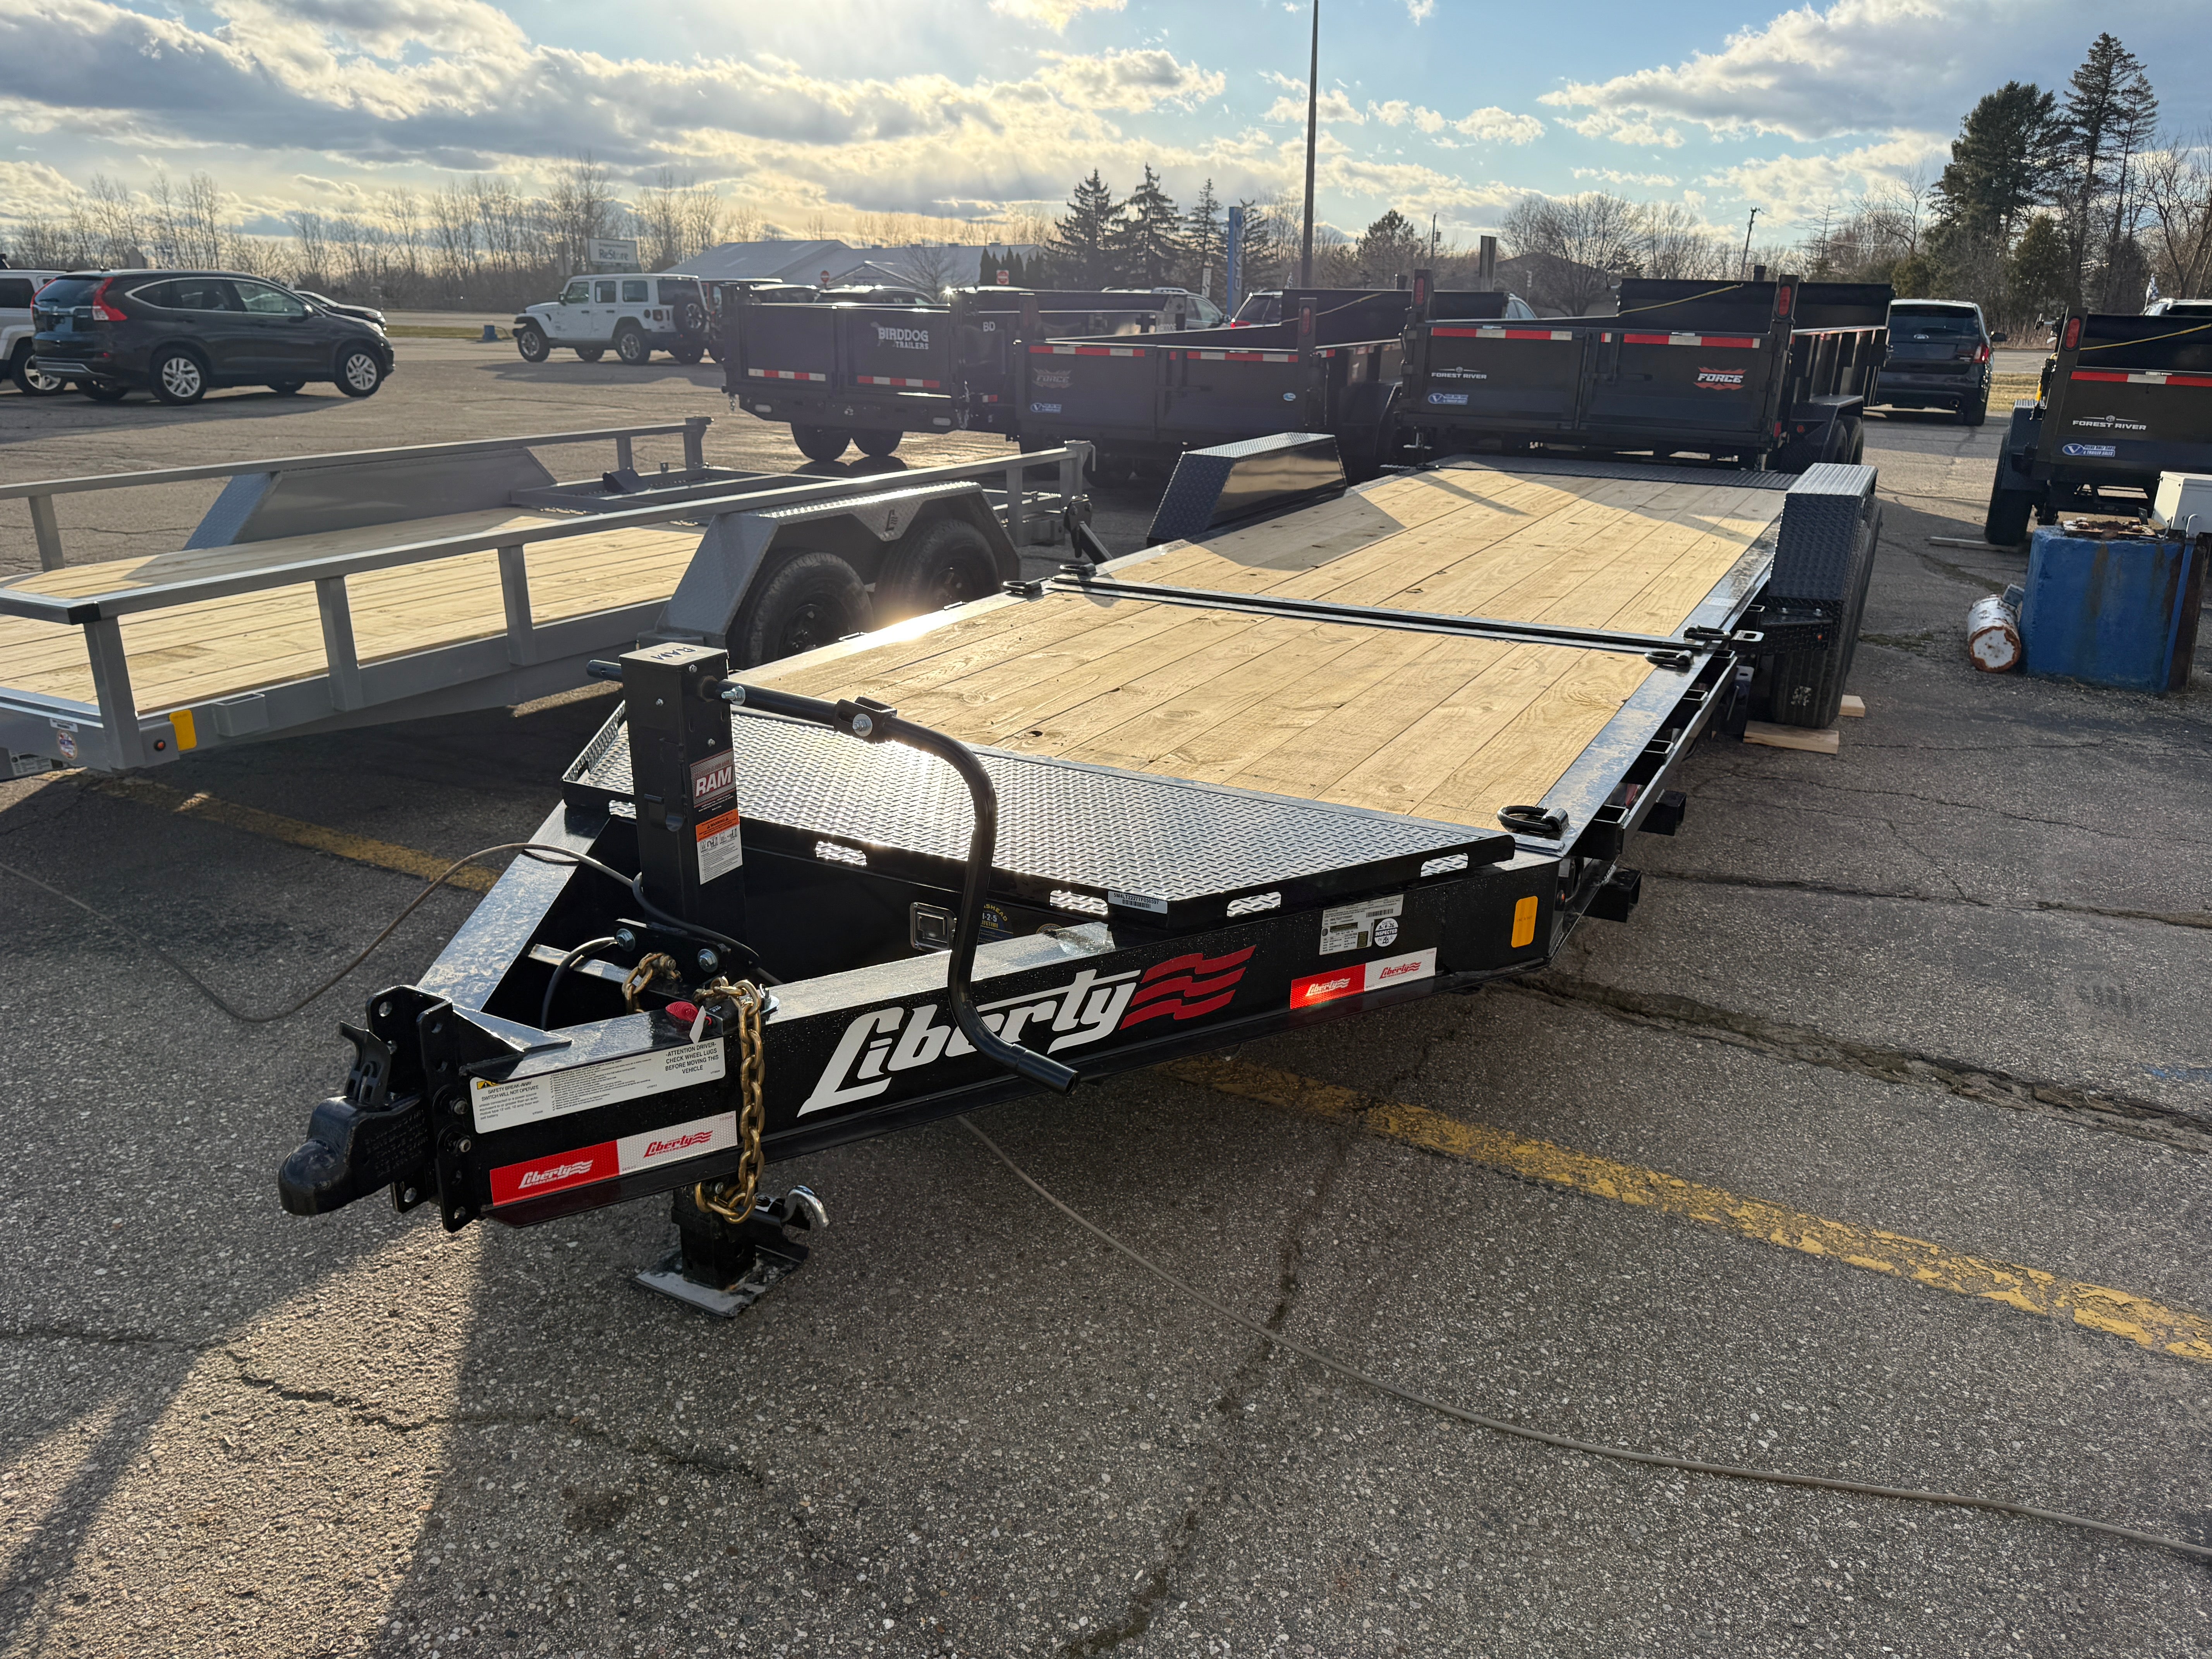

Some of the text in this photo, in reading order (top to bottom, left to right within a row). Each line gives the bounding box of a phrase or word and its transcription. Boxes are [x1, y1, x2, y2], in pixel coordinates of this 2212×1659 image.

[983, 321, 996, 332] BD
[878, 327, 929, 342] BIRDDOG
[895, 341, 929, 350] TRAILERS
[1697, 373, 1743, 383] FORCE
[2073, 420, 2113, 428] FOREST
[696, 766, 733, 797] RAM
[984, 904, 1008, 921] SHEAD
[981, 920, 998, 929] IFETIME
[1375, 928, 1398, 936] INSPECTED
[1379, 963, 1410, 979] Liberty
[797, 969, 1141, 1118] Liberty
[665, 1062, 686, 1071] BEFORE
[687, 1058, 707, 1066] MOVING
[682, 1065, 704, 1074] VEHICLE
[519, 1085, 539, 1093] OPERATE
[643, 1135, 694, 1158] Liberty
[518, 1164, 572, 1189] Liberty
